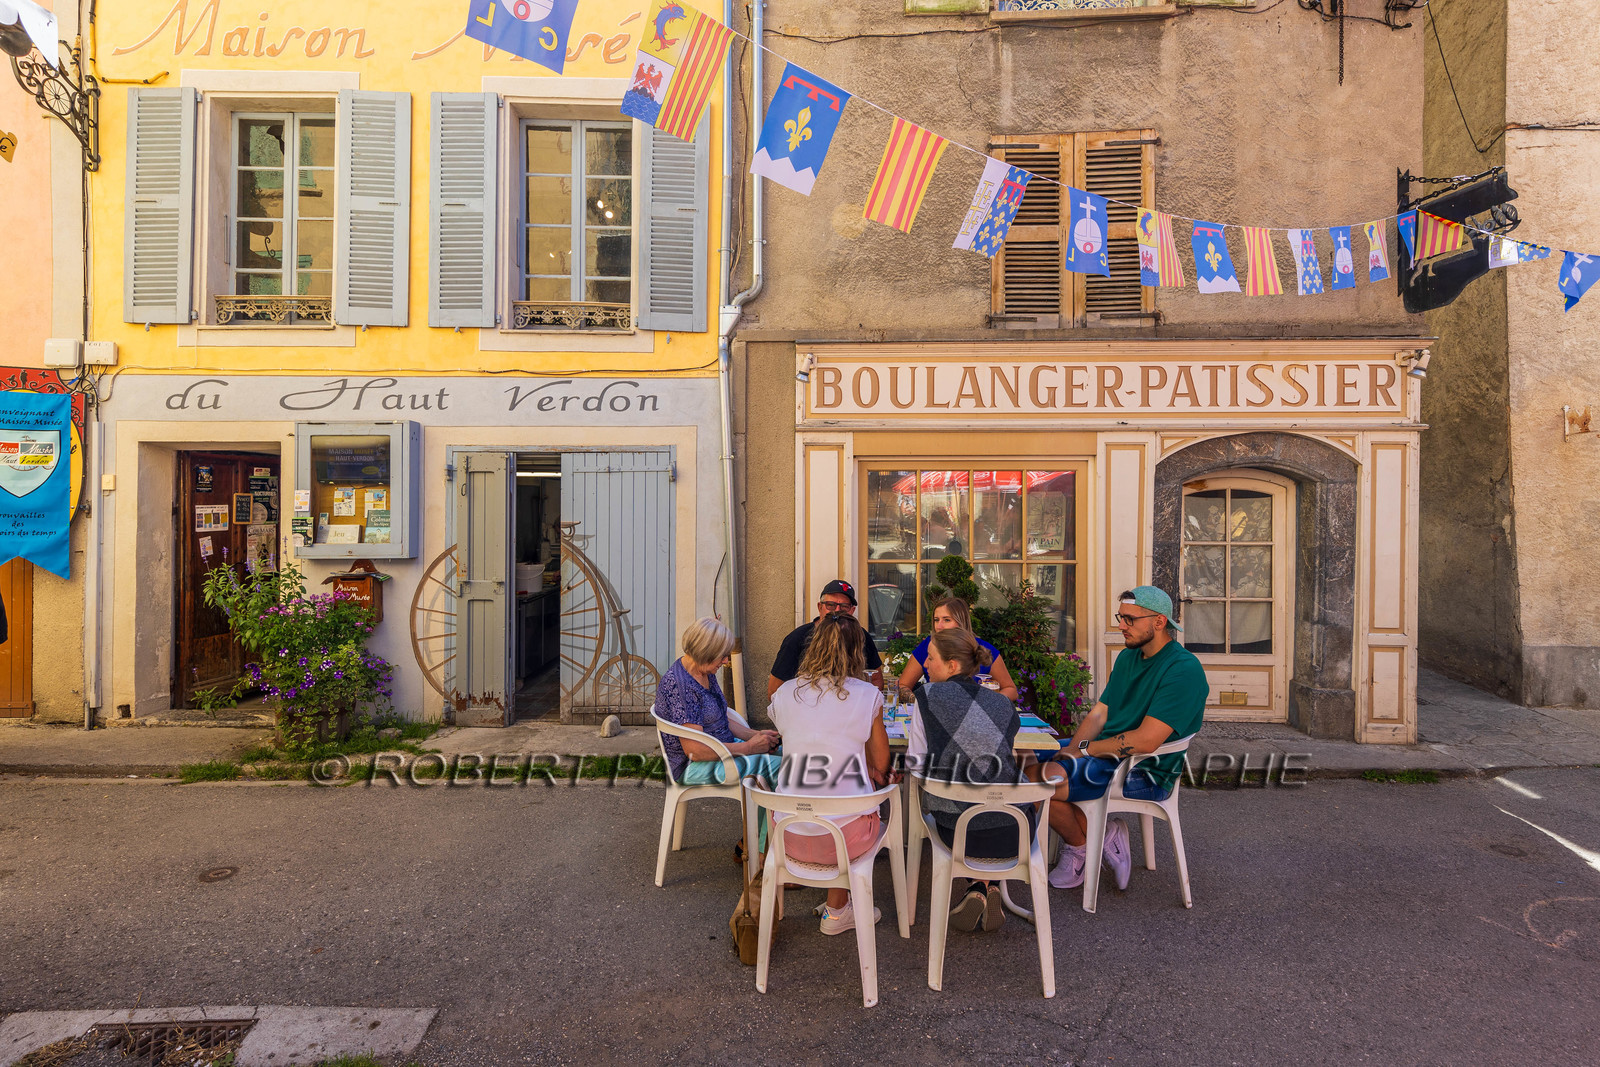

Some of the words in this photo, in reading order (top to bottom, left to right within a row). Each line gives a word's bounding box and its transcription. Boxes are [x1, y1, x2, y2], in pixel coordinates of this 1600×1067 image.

[112, 0, 375, 58] Maison
[165, 380, 229, 411] du
[279, 377, 449, 411] Haut
[504, 380, 659, 412] Verdon
[816, 363, 1398, 410] BOULANGER-PATISSIER
[12, 521, 24, 529] des
[32, 530, 57, 539] temps
[1040, 537, 1060, 545] PAIN
